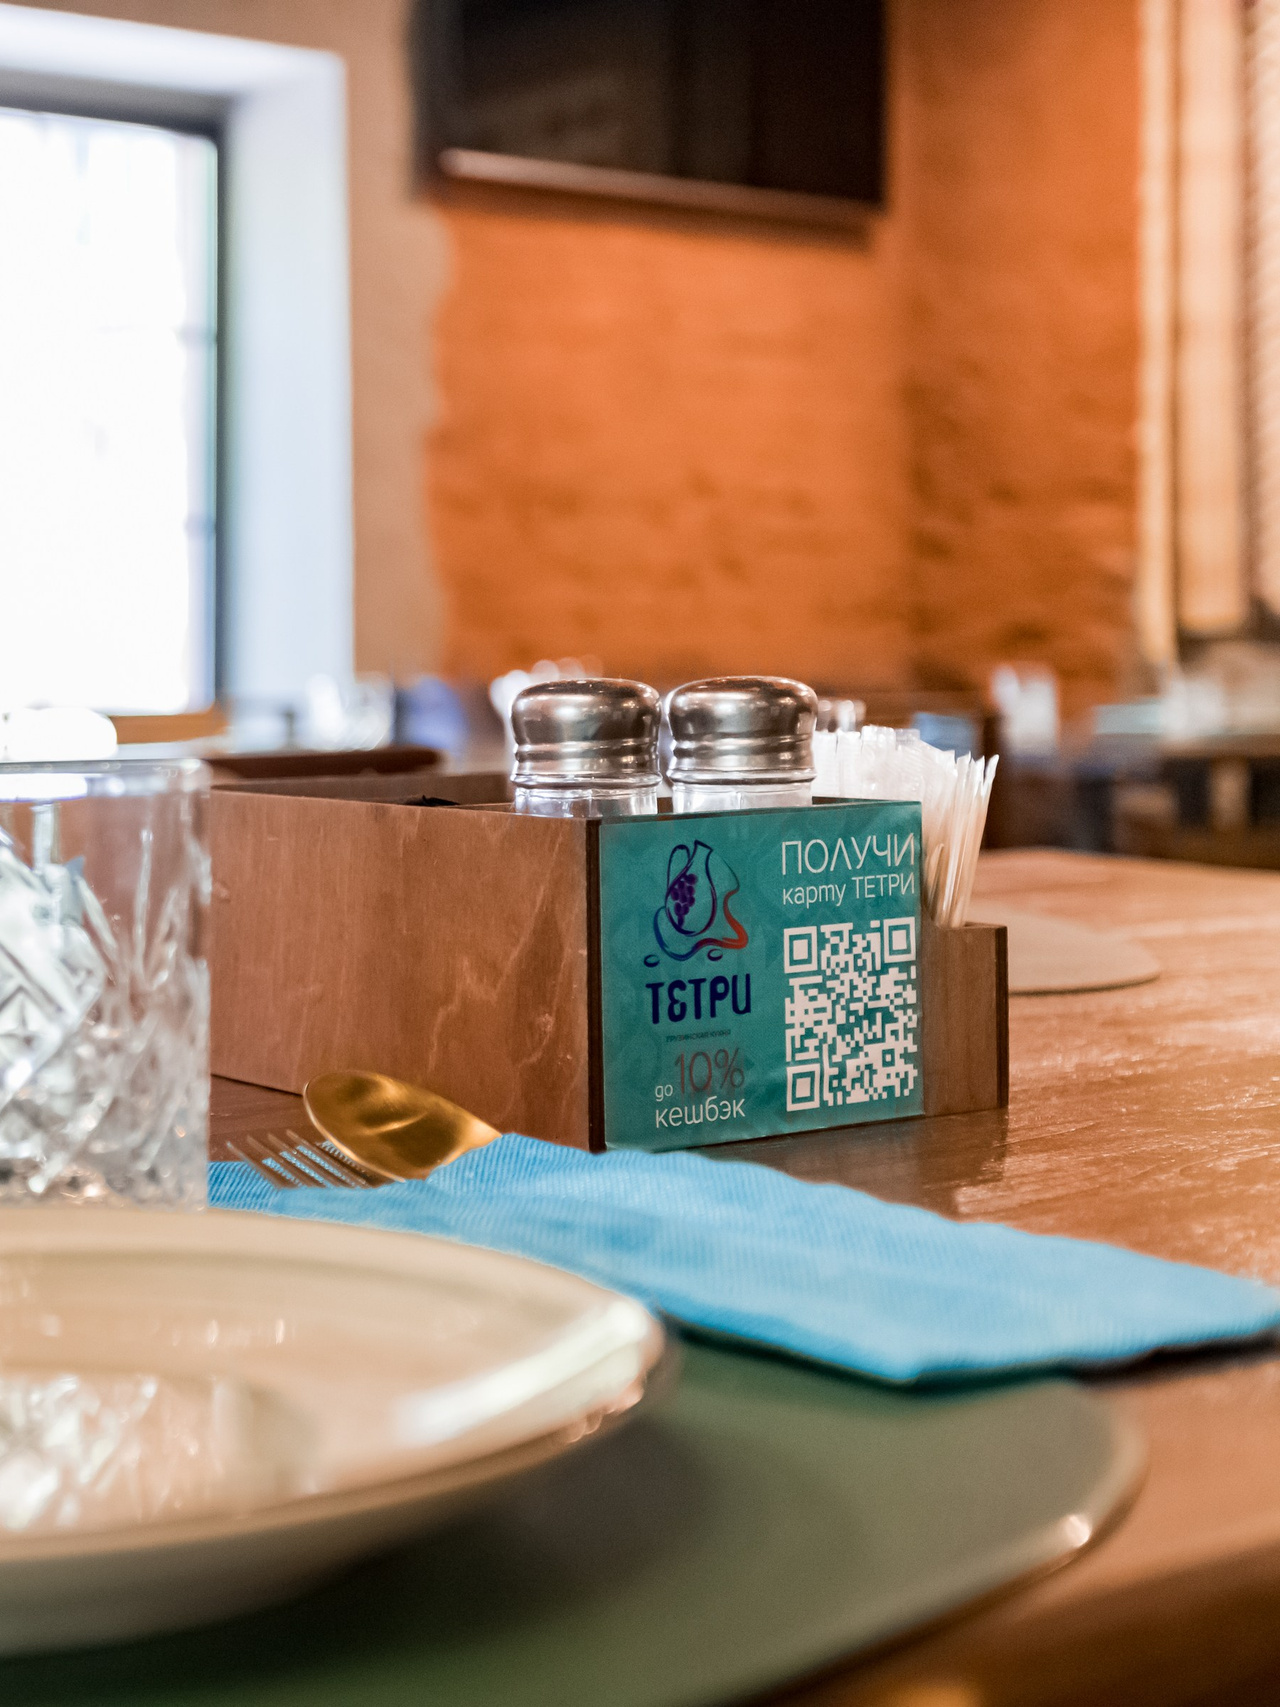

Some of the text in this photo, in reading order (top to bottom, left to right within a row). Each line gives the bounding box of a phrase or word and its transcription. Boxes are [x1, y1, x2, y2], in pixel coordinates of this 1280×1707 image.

[781, 832, 915, 875] ПОЛУЧИ
[783, 872, 915, 909] карту ТЕТРИ
[655, 1047, 745, 1102] до 10%
[655, 1096, 746, 1128] кешбэк
